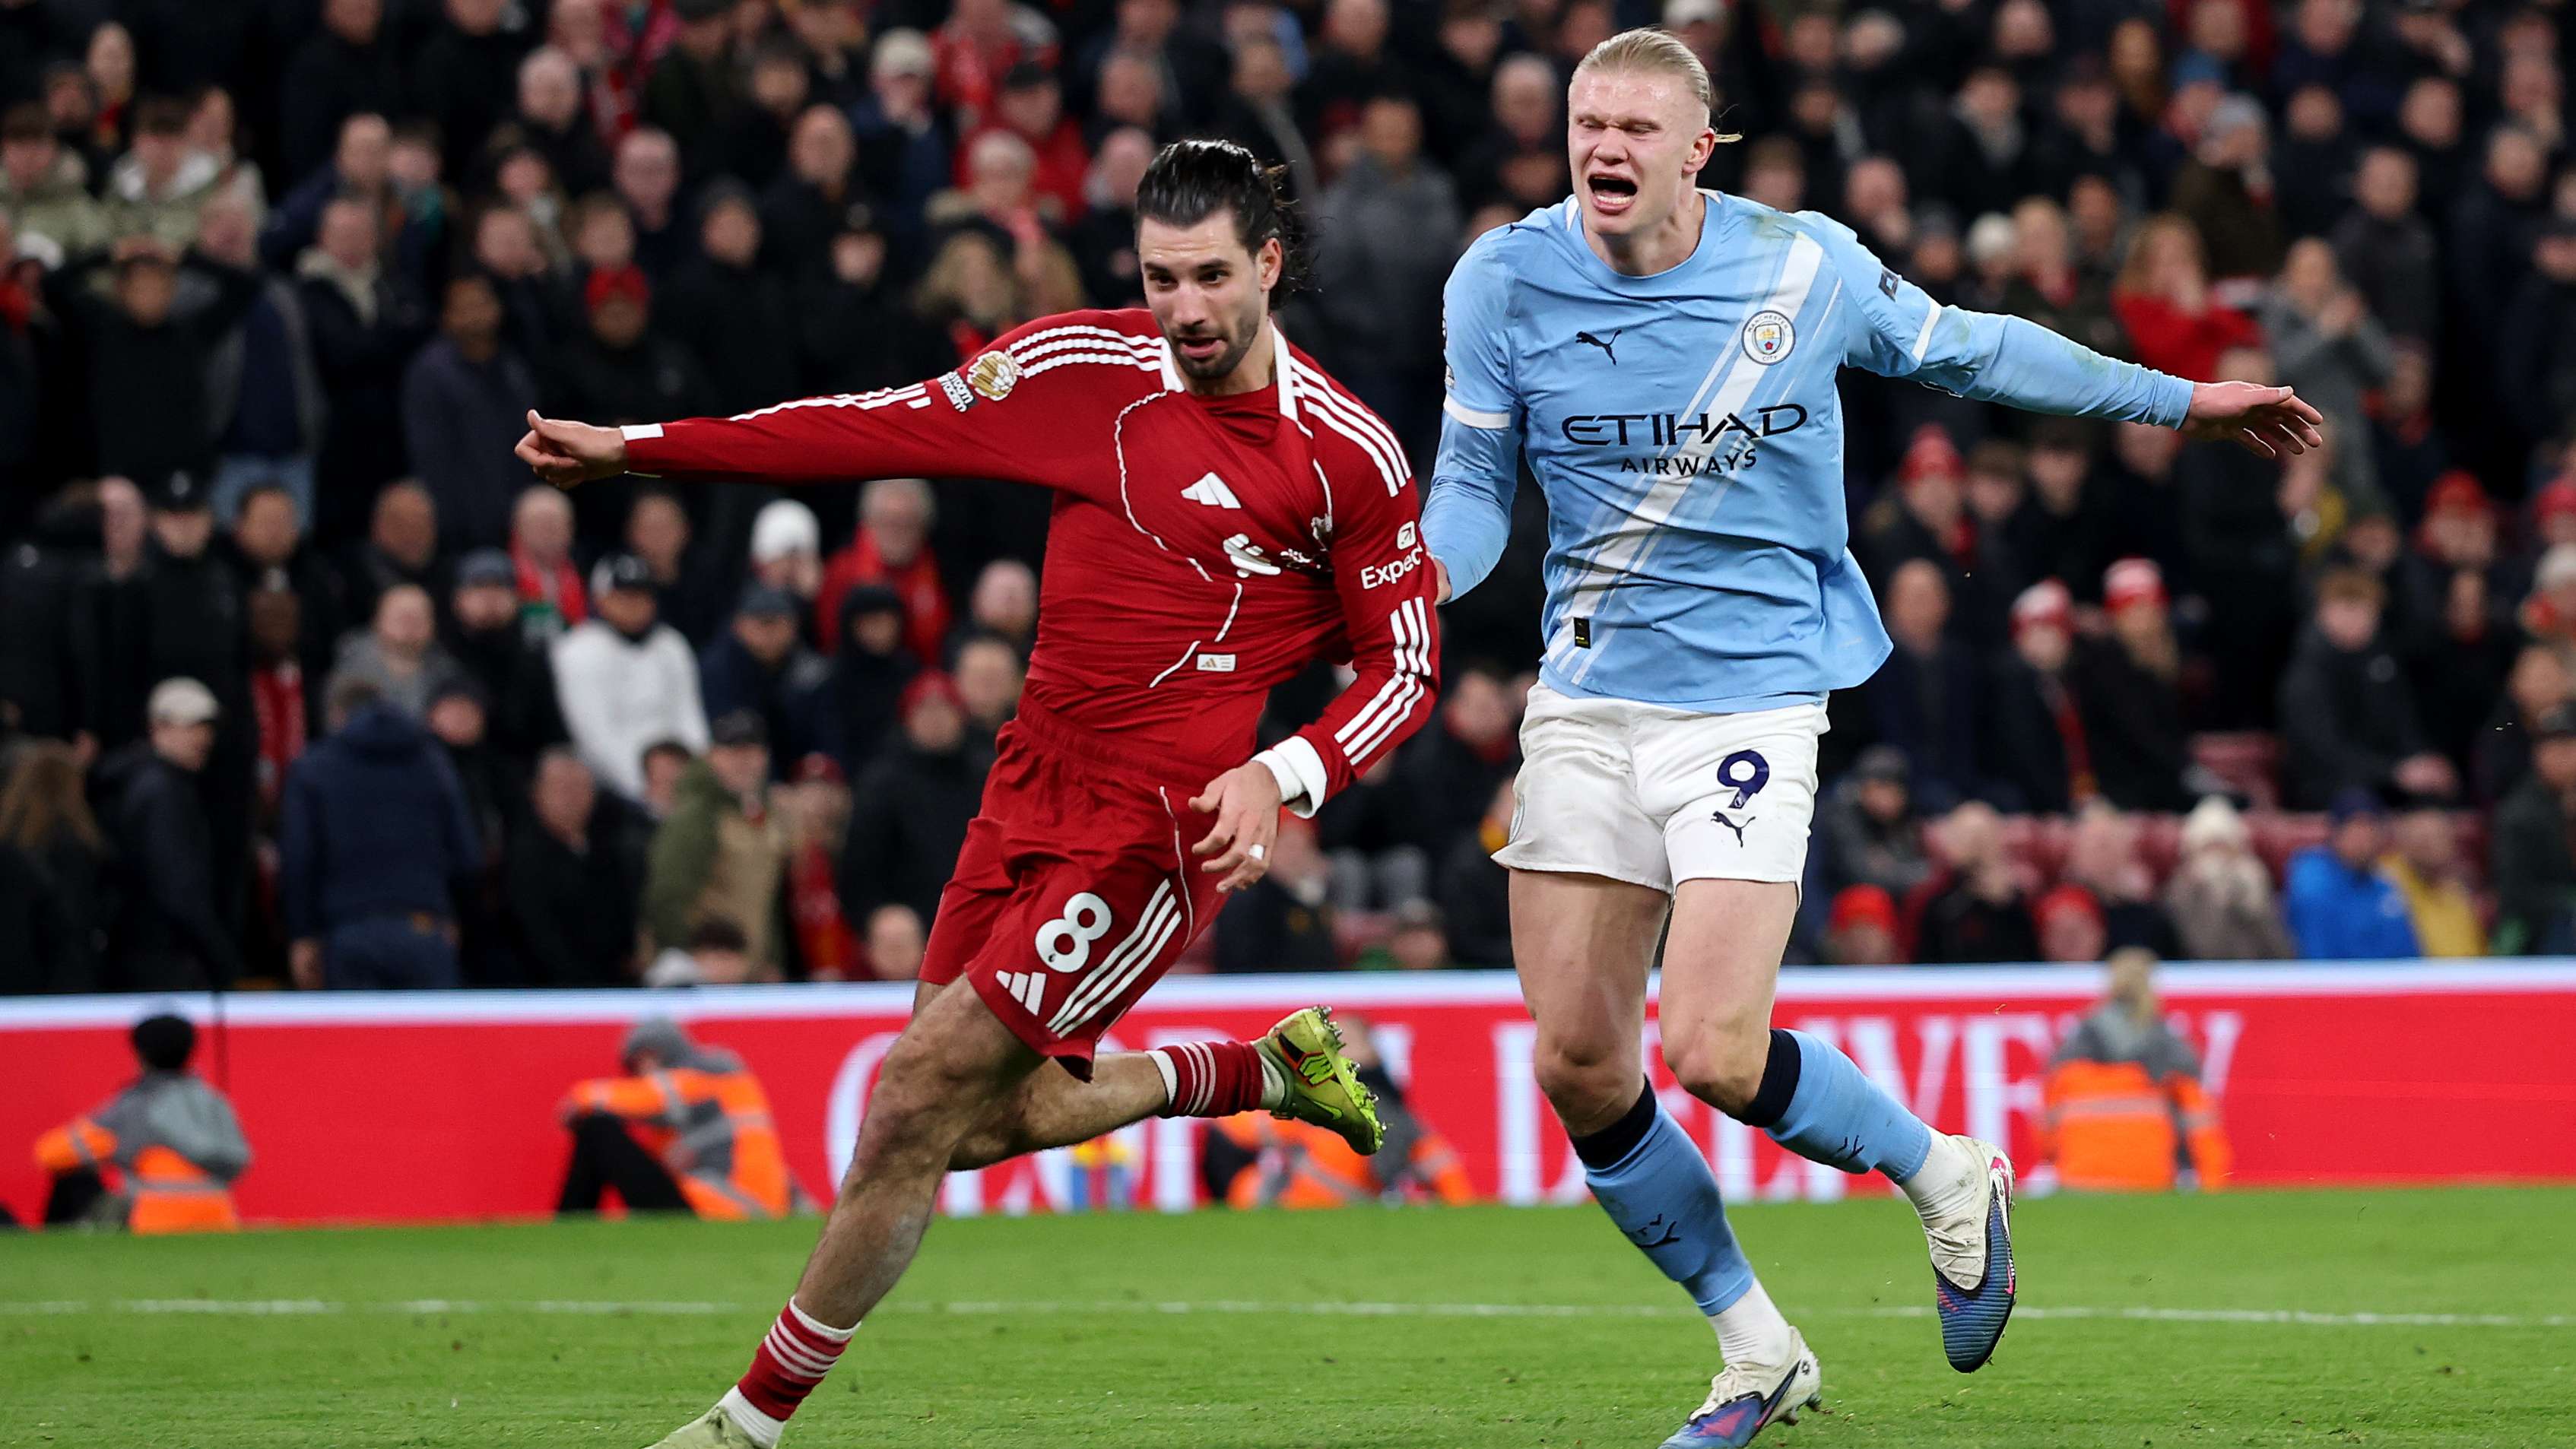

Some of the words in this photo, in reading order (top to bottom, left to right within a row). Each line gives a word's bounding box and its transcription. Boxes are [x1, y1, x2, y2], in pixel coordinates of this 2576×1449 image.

[1561, 403, 1808, 446] ETIHAD
[1620, 449, 1757, 476] AIRWAYS
[1717, 749, 1770, 809] 9
[1035, 892, 1112, 973] 8
